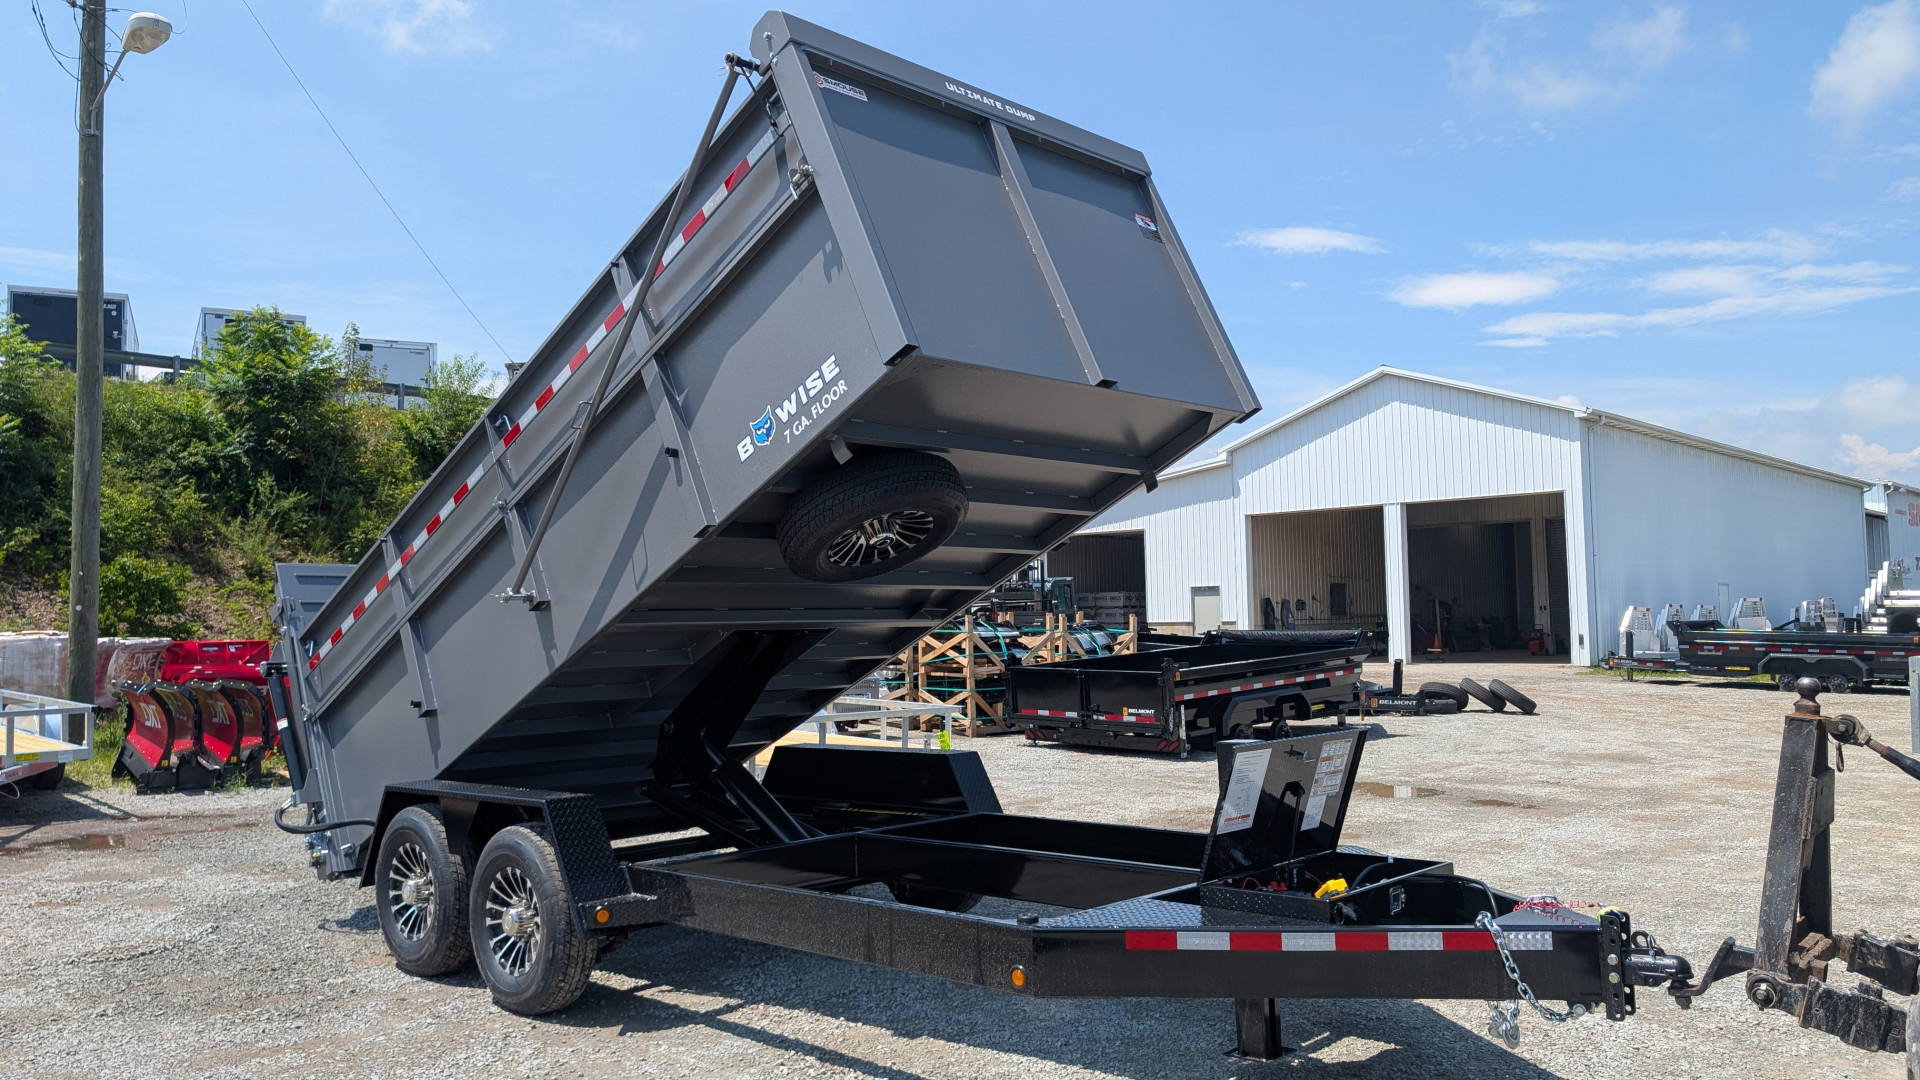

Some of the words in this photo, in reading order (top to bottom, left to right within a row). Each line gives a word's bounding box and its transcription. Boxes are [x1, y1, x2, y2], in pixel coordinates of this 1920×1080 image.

[823, 77, 865, 97] SMOUSE
[945, 81, 1004, 110] ULTIMATE
[1005, 104, 1036, 122] DUMP
[783, 430, 791, 444] 7
[793, 415, 812, 435] GA.
[811, 379, 848, 419] FLOOR
